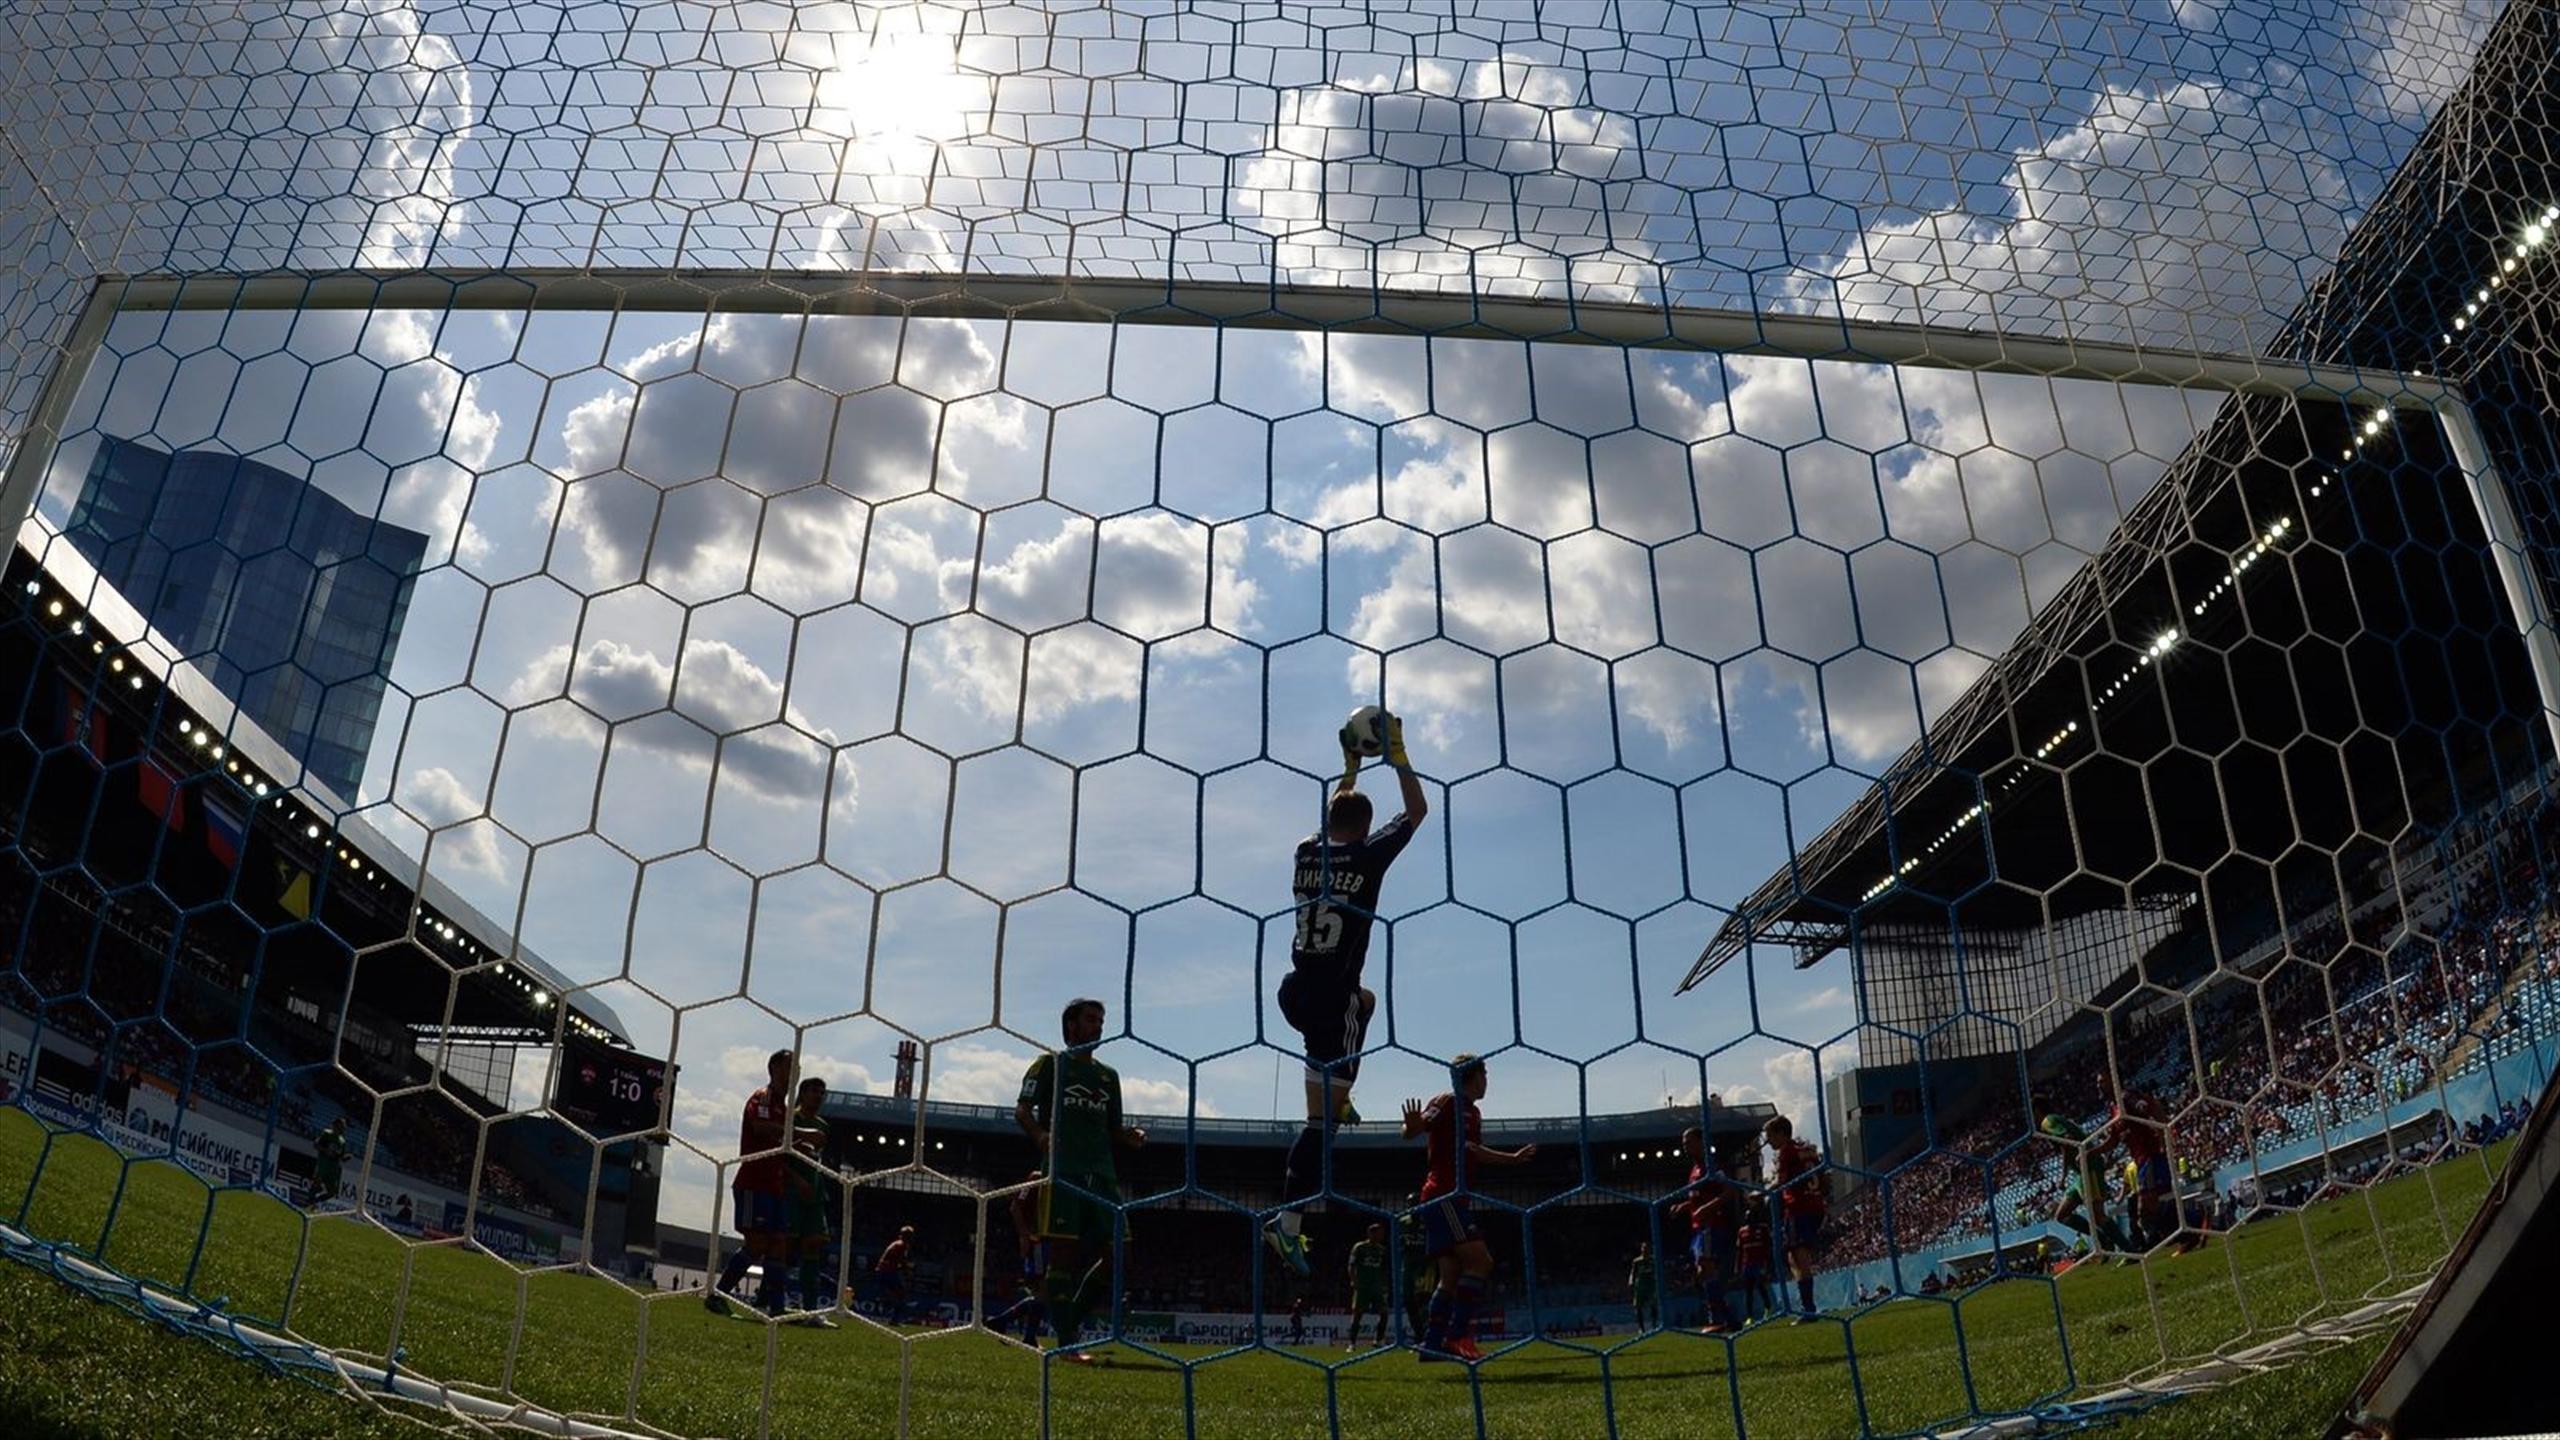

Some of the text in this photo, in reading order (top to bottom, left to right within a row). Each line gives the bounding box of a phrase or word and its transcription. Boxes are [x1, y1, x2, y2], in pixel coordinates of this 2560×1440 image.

[609, 1078, 641, 1102] 1:0
[71, 1091, 125, 1126] adidas
[244, 1154, 275, 1179] СЕИ
[342, 1182, 393, 1208] KAZLER
